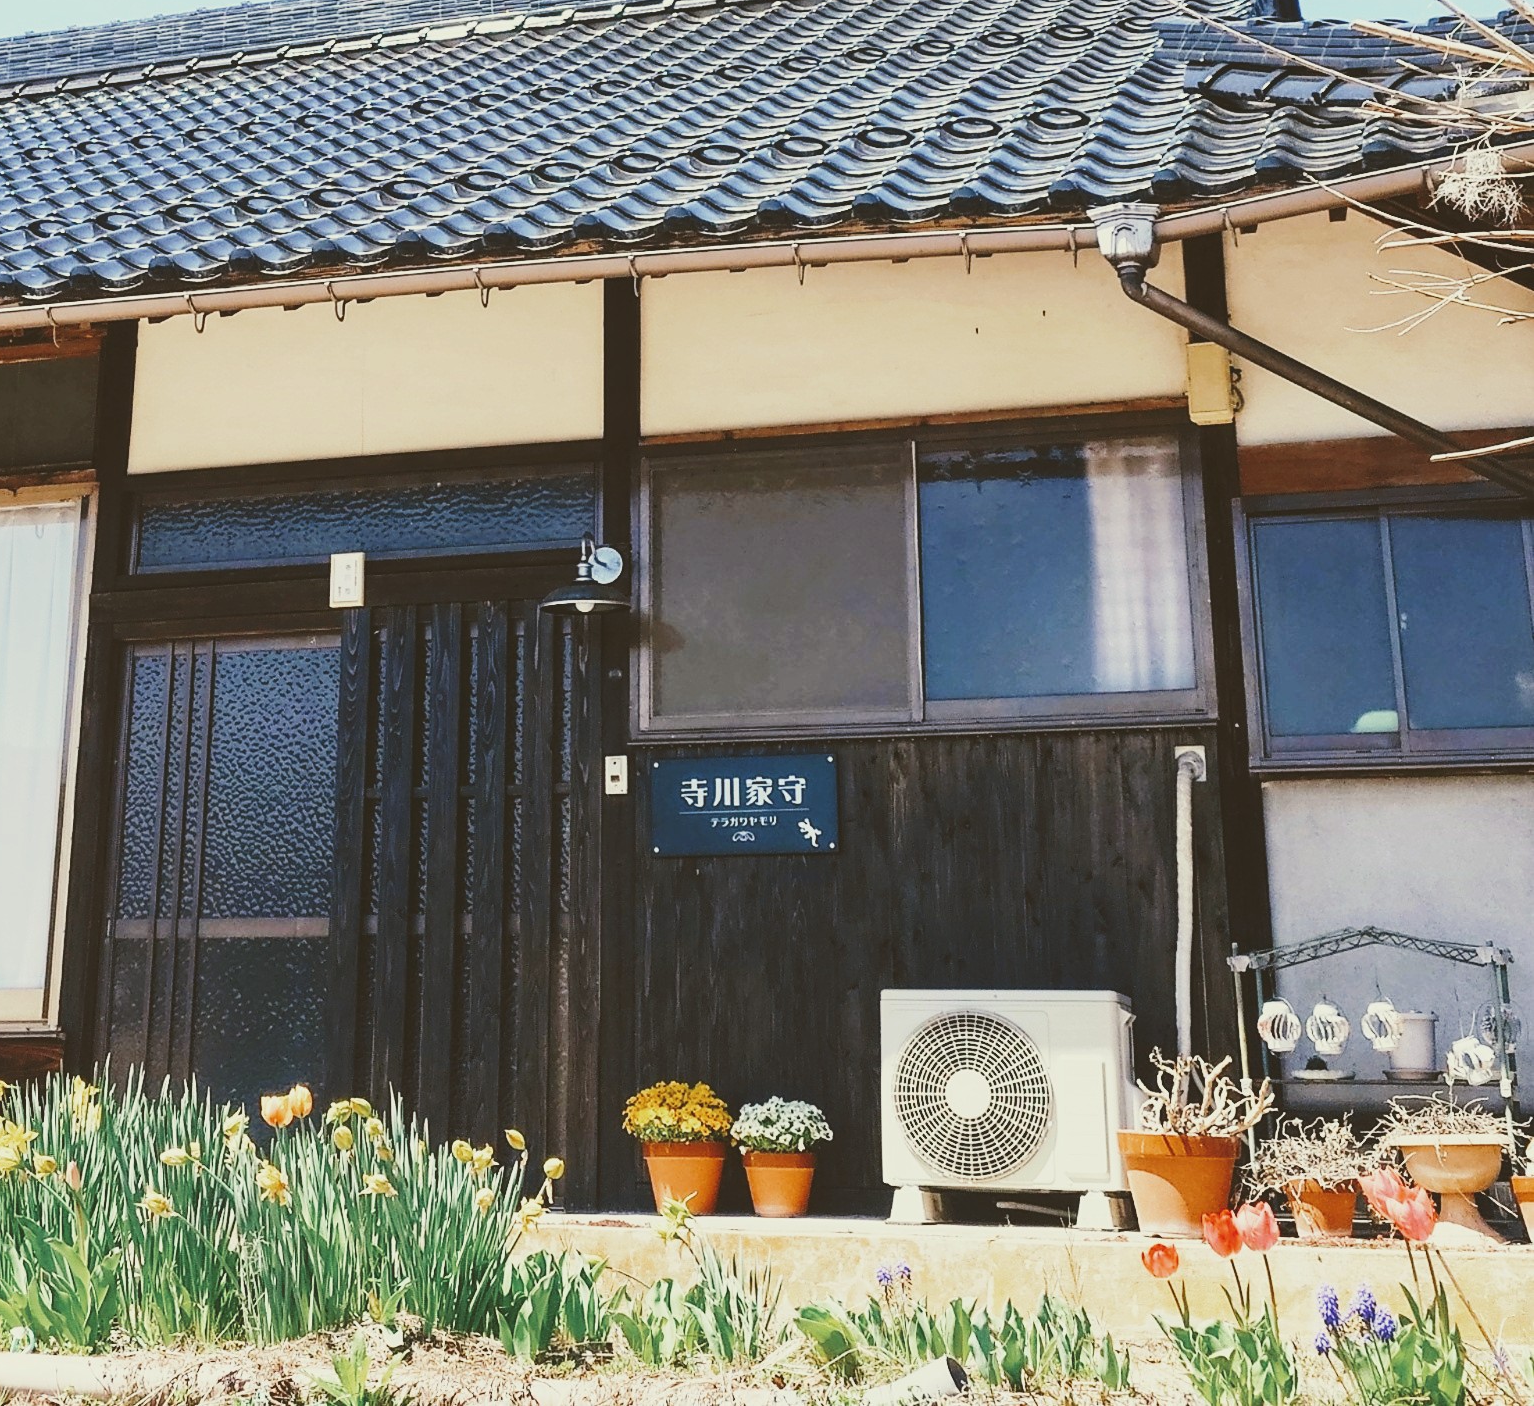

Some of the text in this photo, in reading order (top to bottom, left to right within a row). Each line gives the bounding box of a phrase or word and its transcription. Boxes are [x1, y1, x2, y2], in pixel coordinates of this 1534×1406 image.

[680, 775, 807, 808] 寺川家守
[710, 815, 777, 828] テラガワヤモリ
